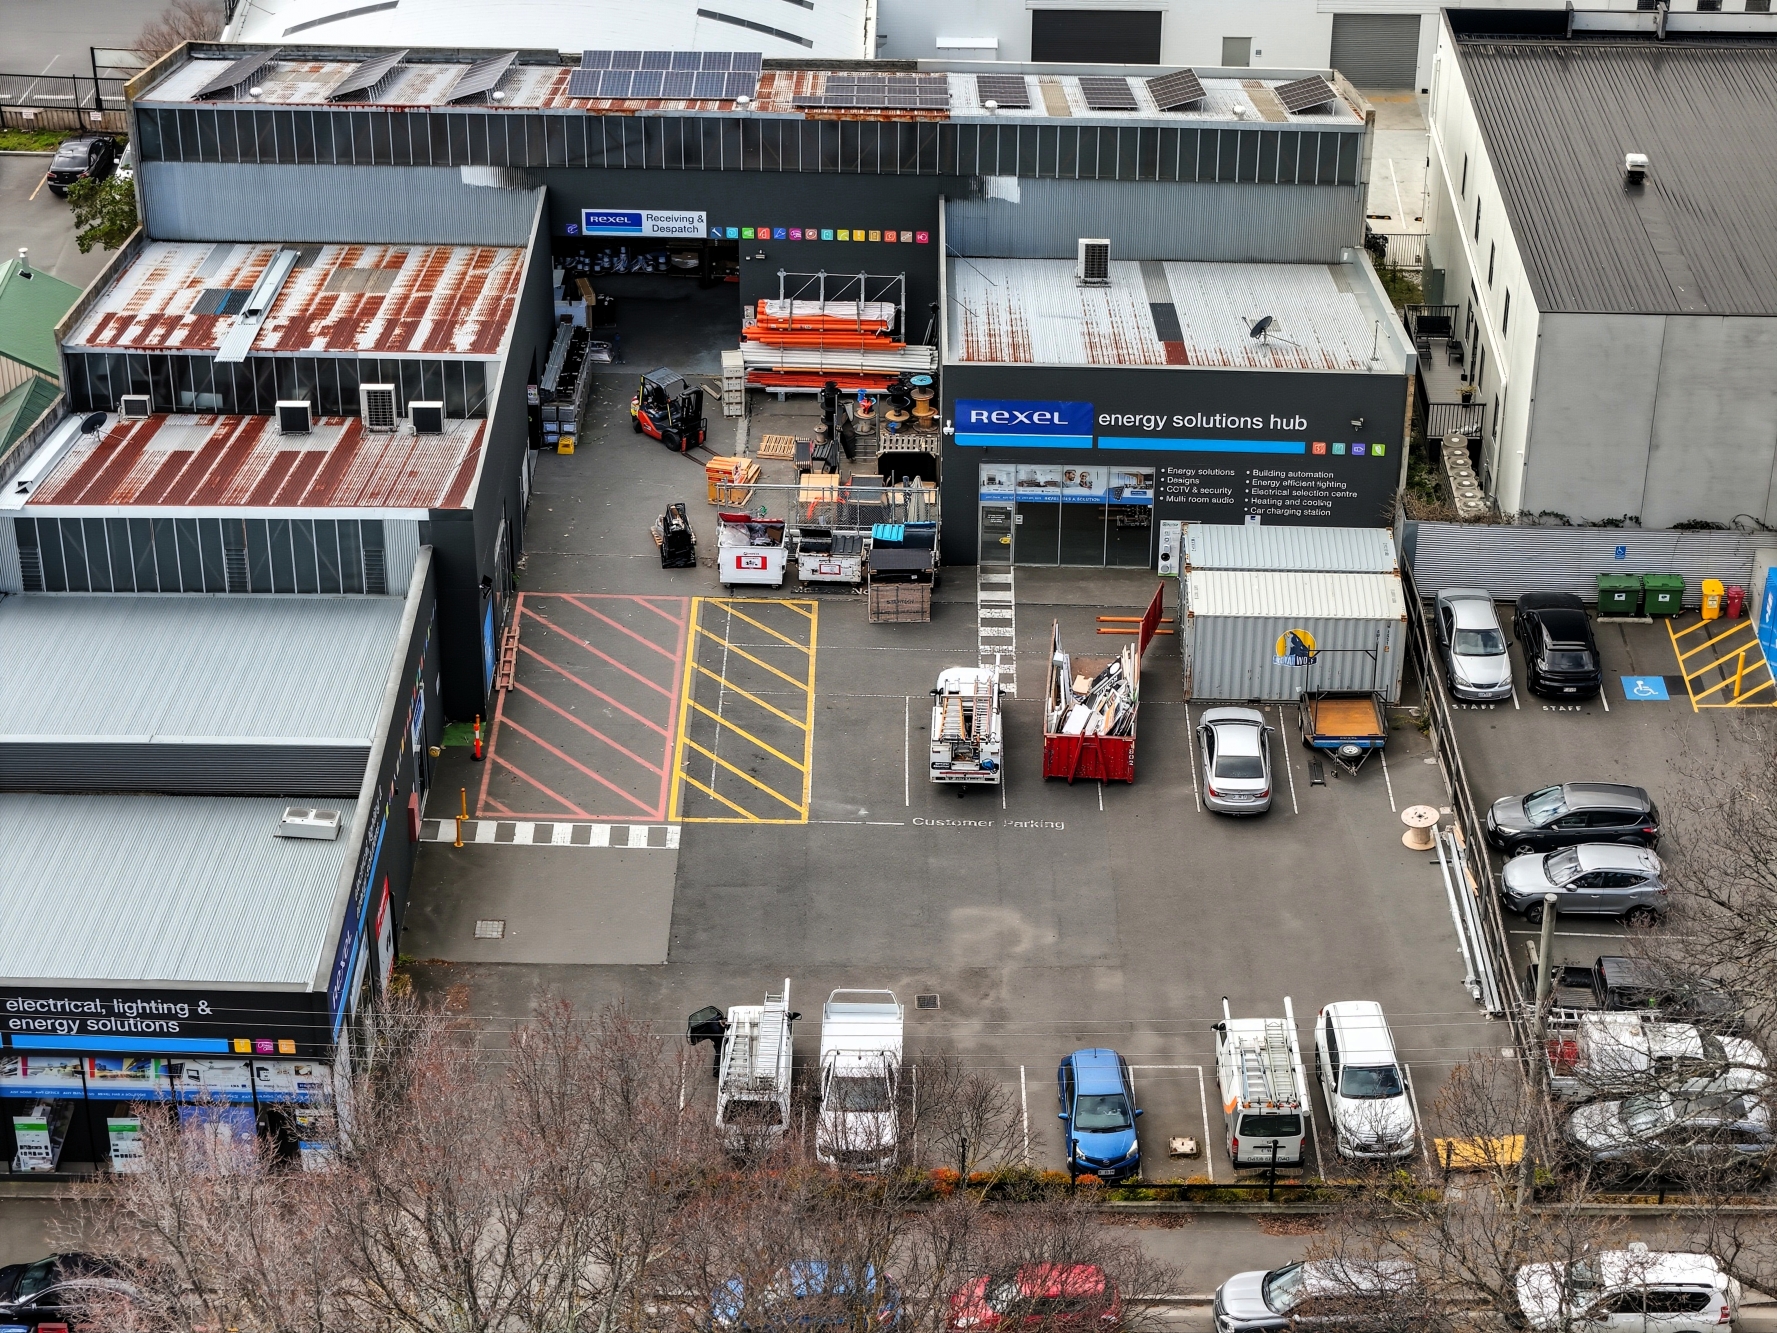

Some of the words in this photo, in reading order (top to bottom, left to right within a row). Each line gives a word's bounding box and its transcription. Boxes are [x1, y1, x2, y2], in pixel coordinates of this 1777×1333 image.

[646, 214, 694, 224] Receiving
[697, 215, 704, 223] &
[652, 224, 698, 234] Despatch
[1098, 412, 1167, 431] energy
[1172, 412, 1264, 430] solutions
[1269, 414, 1308, 430] hub
[1168, 468, 1196, 476] Energy
[1253, 470, 1286, 478] Building
[1167, 477, 1200, 485] Designs
[1252, 479, 1280, 487] Energy
[1282, 480, 1315, 488] efficient
[1200, 487, 1232, 495] security
[1252, 488, 1289, 496] Electrical
[1251, 497, 1282, 506] Heating
[1302, 498, 1332, 507] cooling
[1267, 507, 1302, 516] charging
[912, 817, 994, 827] Customer
[1004, 819, 1065, 830] Parking
[6, 997, 106, 1015] electrical,
[114, 999, 189, 1018] lighting
[197, 1000, 213, 1015] &
[8, 1018, 80, 1035] energy
[86, 1017, 180, 1033] solutions
